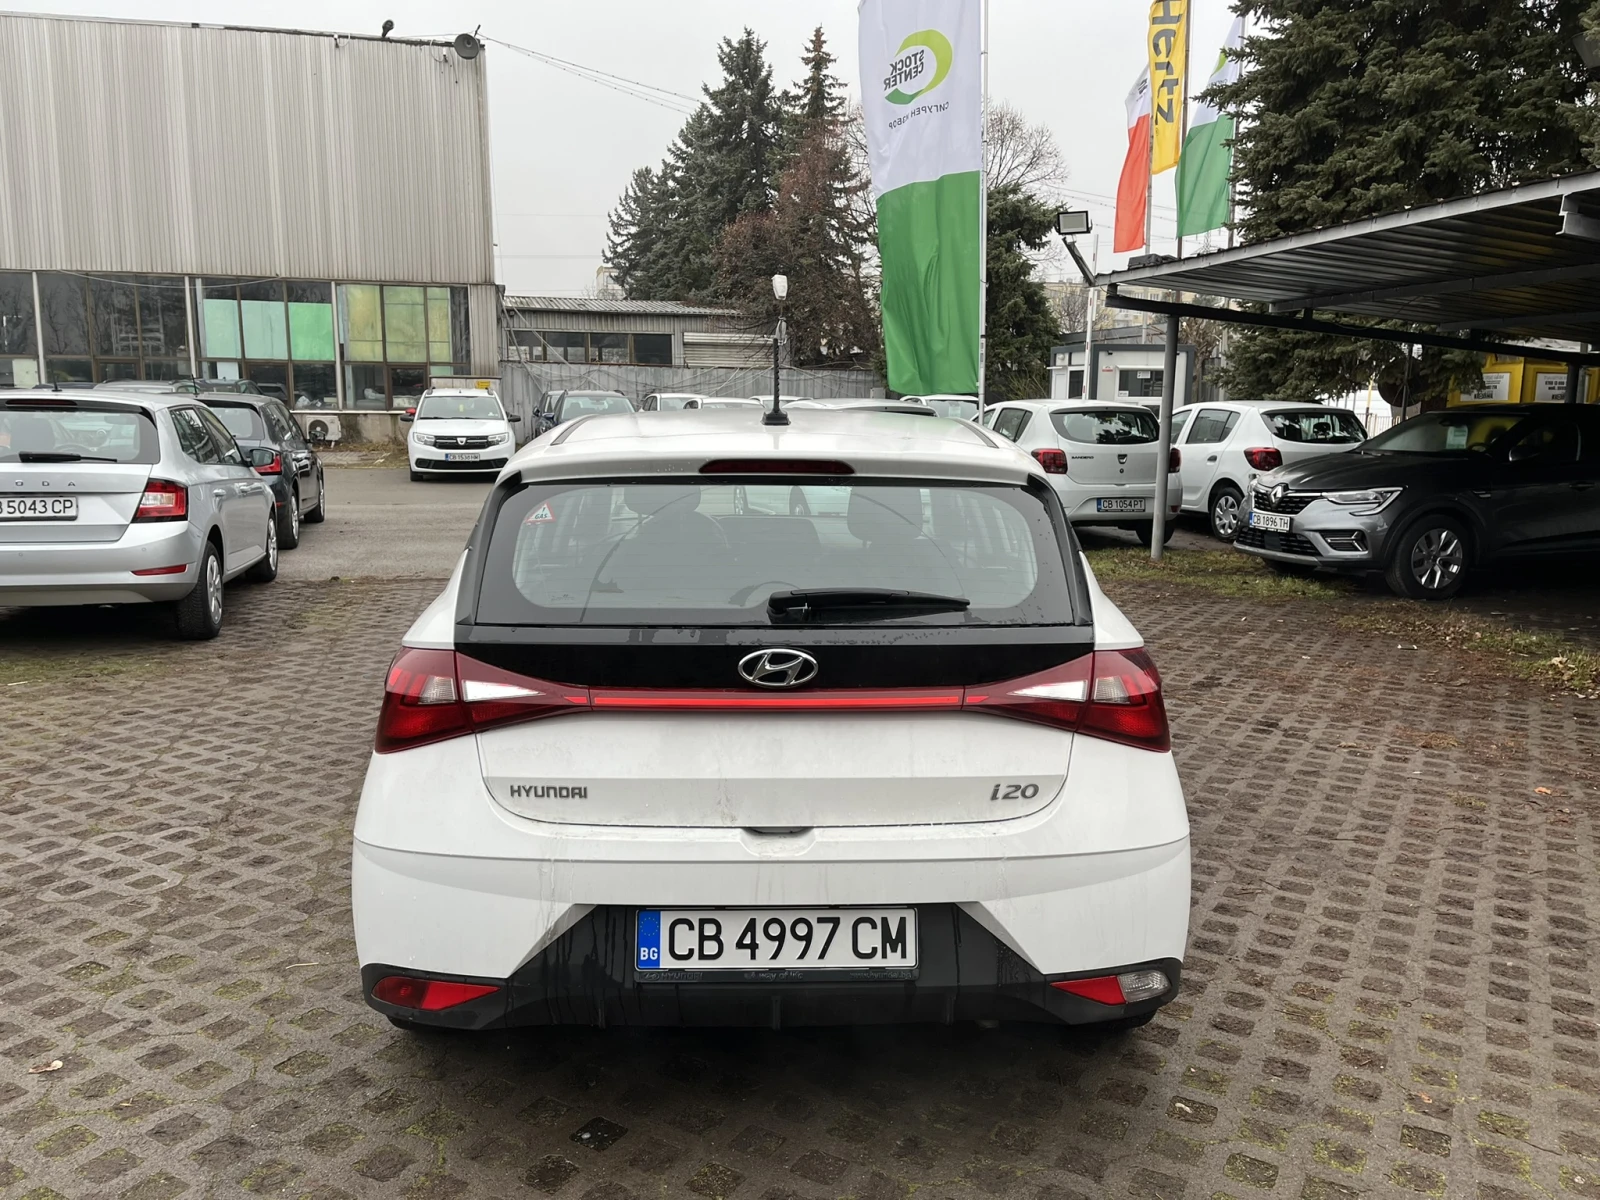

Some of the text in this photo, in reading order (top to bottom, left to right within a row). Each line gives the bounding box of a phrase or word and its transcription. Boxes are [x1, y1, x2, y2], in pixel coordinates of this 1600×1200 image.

[1151, 0, 1182, 125] Hertz
[6, 499, 48, 515] 5043
[52, 499, 73, 514] CP
[1102, 499, 1143, 509] CB 1054 PT
[1253, 514, 1288, 529] CB 1896 TH
[510, 785, 588, 799] HYUNDAI
[990, 783, 1040, 801] i20
[668, 916, 907, 961] CB 4997 CM
[640, 947, 658, 960] BG
